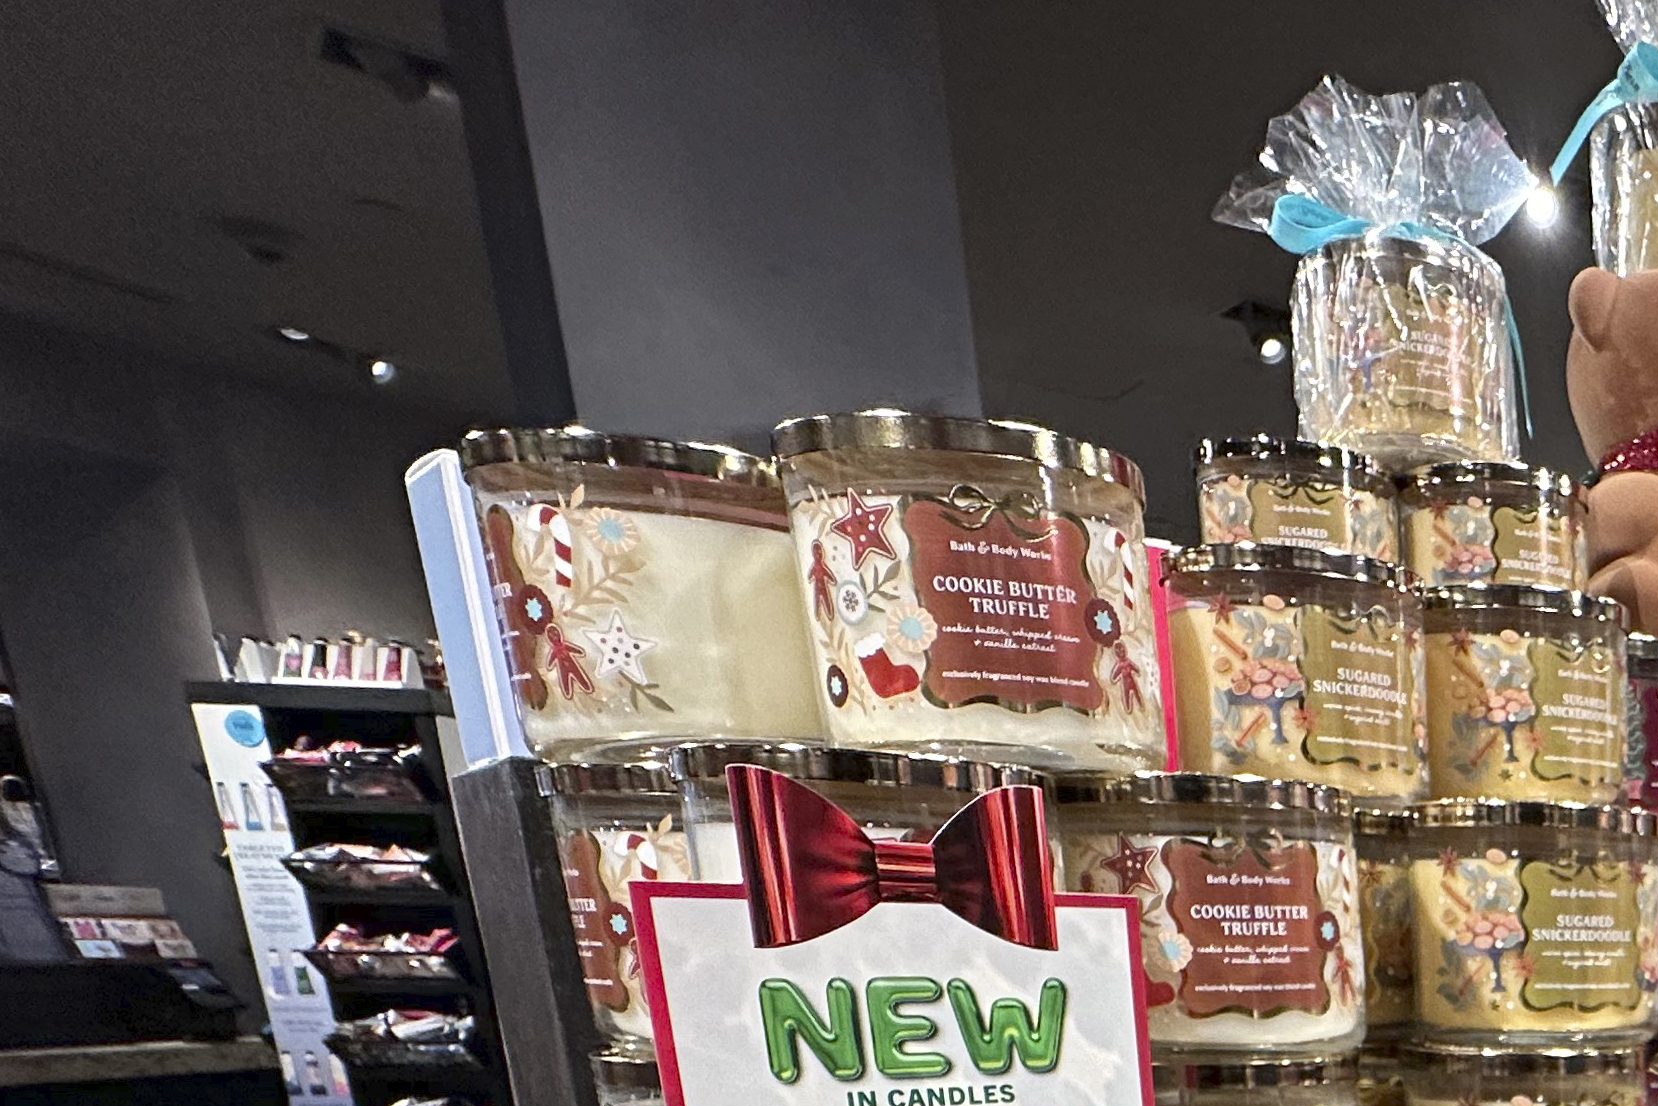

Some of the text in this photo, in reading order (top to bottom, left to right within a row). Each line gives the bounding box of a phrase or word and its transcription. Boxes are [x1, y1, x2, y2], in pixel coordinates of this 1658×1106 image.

[1279, 526, 1328, 538] SUGARED
[950, 540, 1052, 561] Bath & Body Works
[933, 576, 1077, 604] COOKIE BUTTER
[969, 597, 1050, 619] TRUFFLE
[942, 623, 973, 633] cookie
[1337, 667, 1391, 687] SUGARED
[1313, 680, 1407, 705] SNICKERDOODLE
[1207, 873, 1290, 887] Bath & Body Works
[1190, 905, 1308, 919] COOKIE BUTTER
[1556, 914, 1614, 927] SUGARED
[1221, 922, 1287, 935] TRUFFLE
[758, 976, 1069, 1085] NEW
